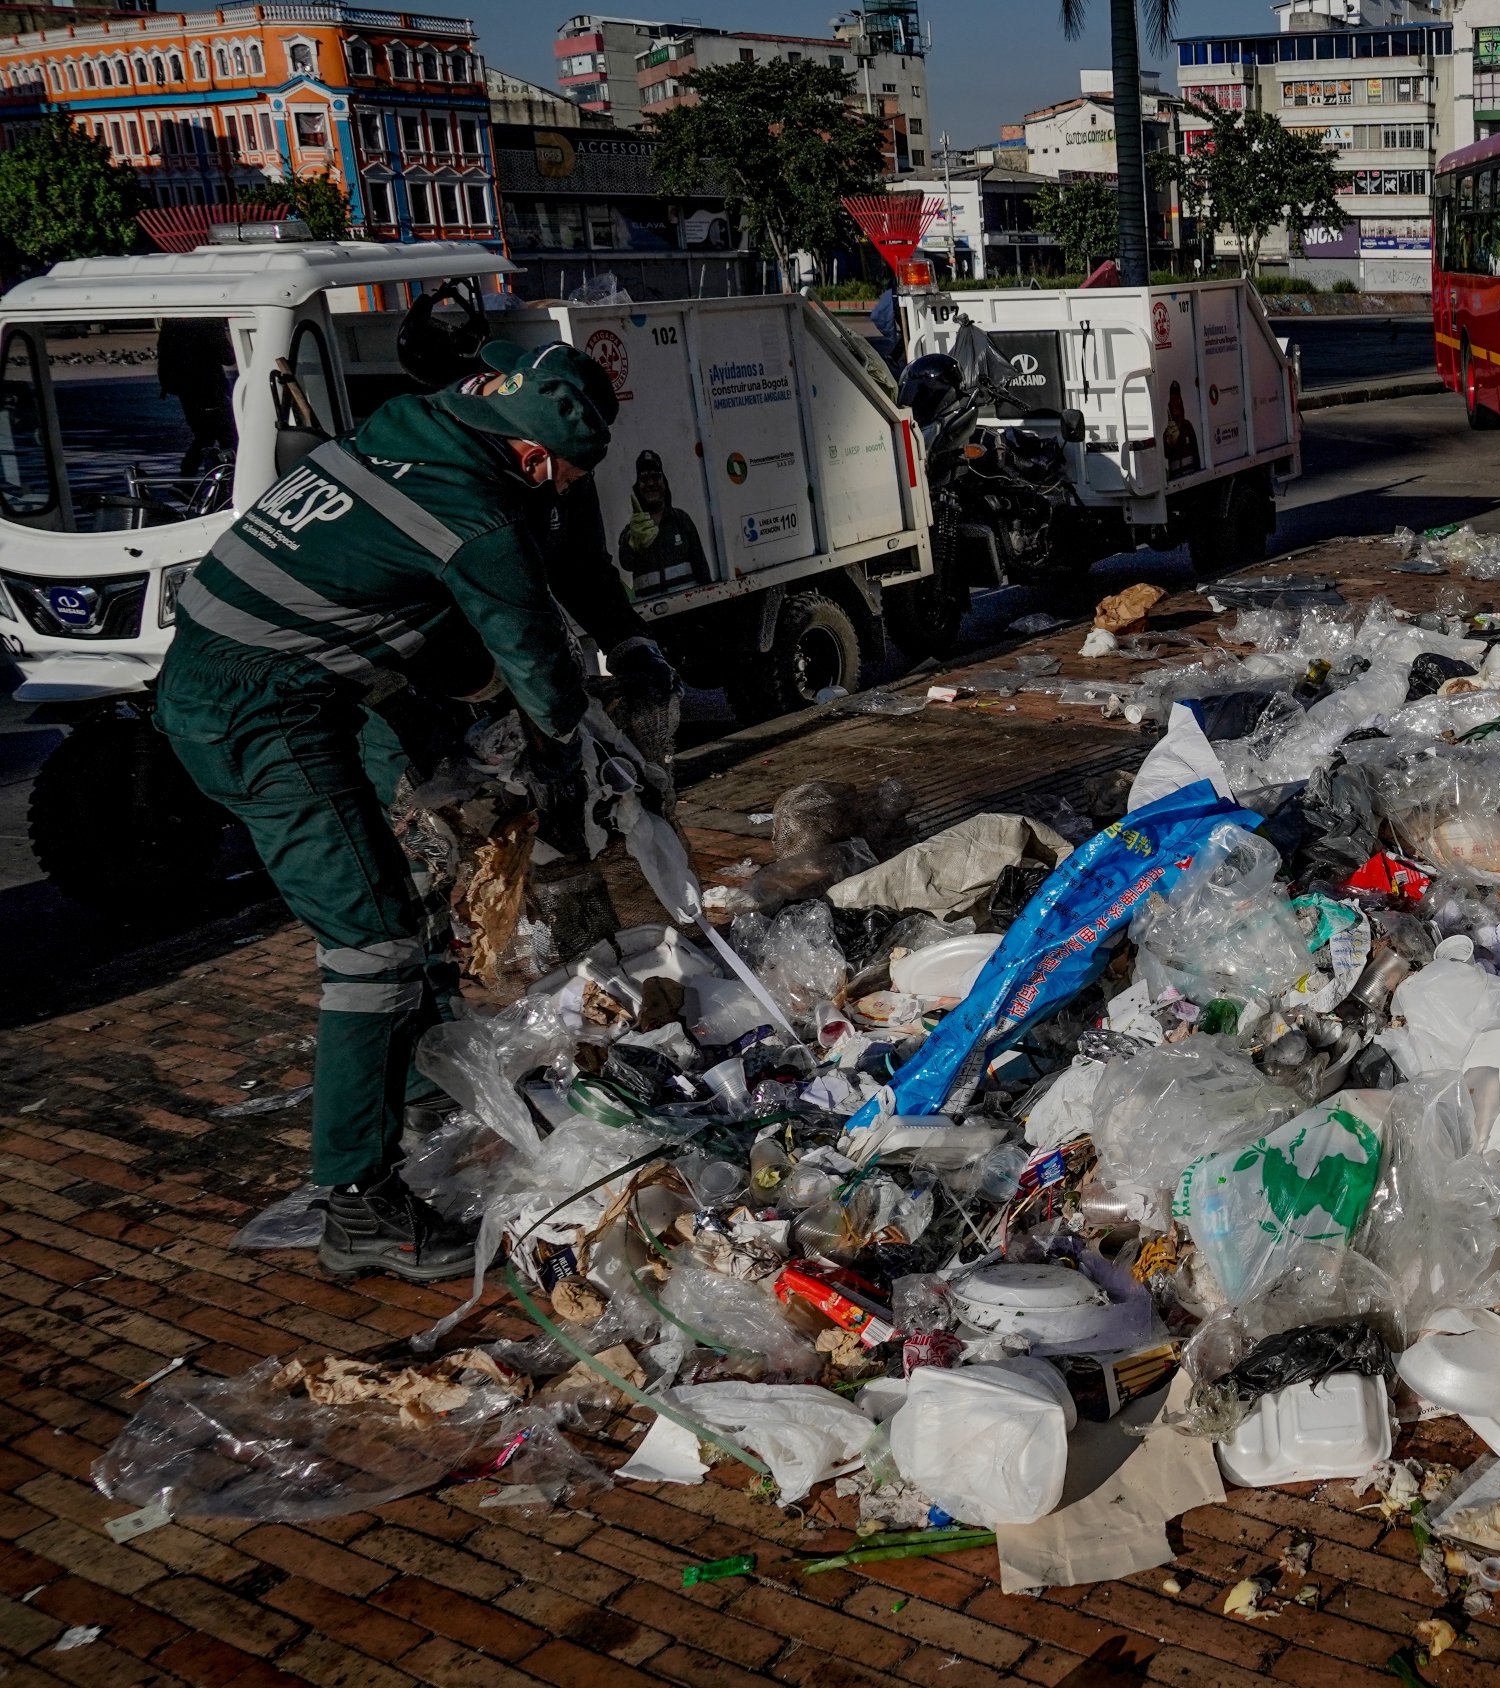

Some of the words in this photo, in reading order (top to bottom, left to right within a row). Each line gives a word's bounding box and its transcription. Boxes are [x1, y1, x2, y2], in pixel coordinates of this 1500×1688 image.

[497, 84, 533, 94] LTDA.
[1072, 171, 1091, 181] SEX
[1094, 172, 1120, 182] SHOP
[931, 306, 959, 321] 107
[1178, 301, 1190, 313] 107
[588, 332, 621, 349] BRIGADA
[652, 326, 678, 346] 102
[709, 361, 758, 385] ¡Ayúdanos
[758, 363, 765, 376] a
[711, 382, 747, 396] construir
[747, 382, 762, 391] una
[761, 376, 789, 391] Bogotá
[713, 393, 764, 410] AMBIENTALMENTE
[256, 464, 354, 533] UAESP
[780, 513, 797, 531] 110
[272, 529, 301, 551] Especial
[558, 1256, 574, 1277] RELAX
